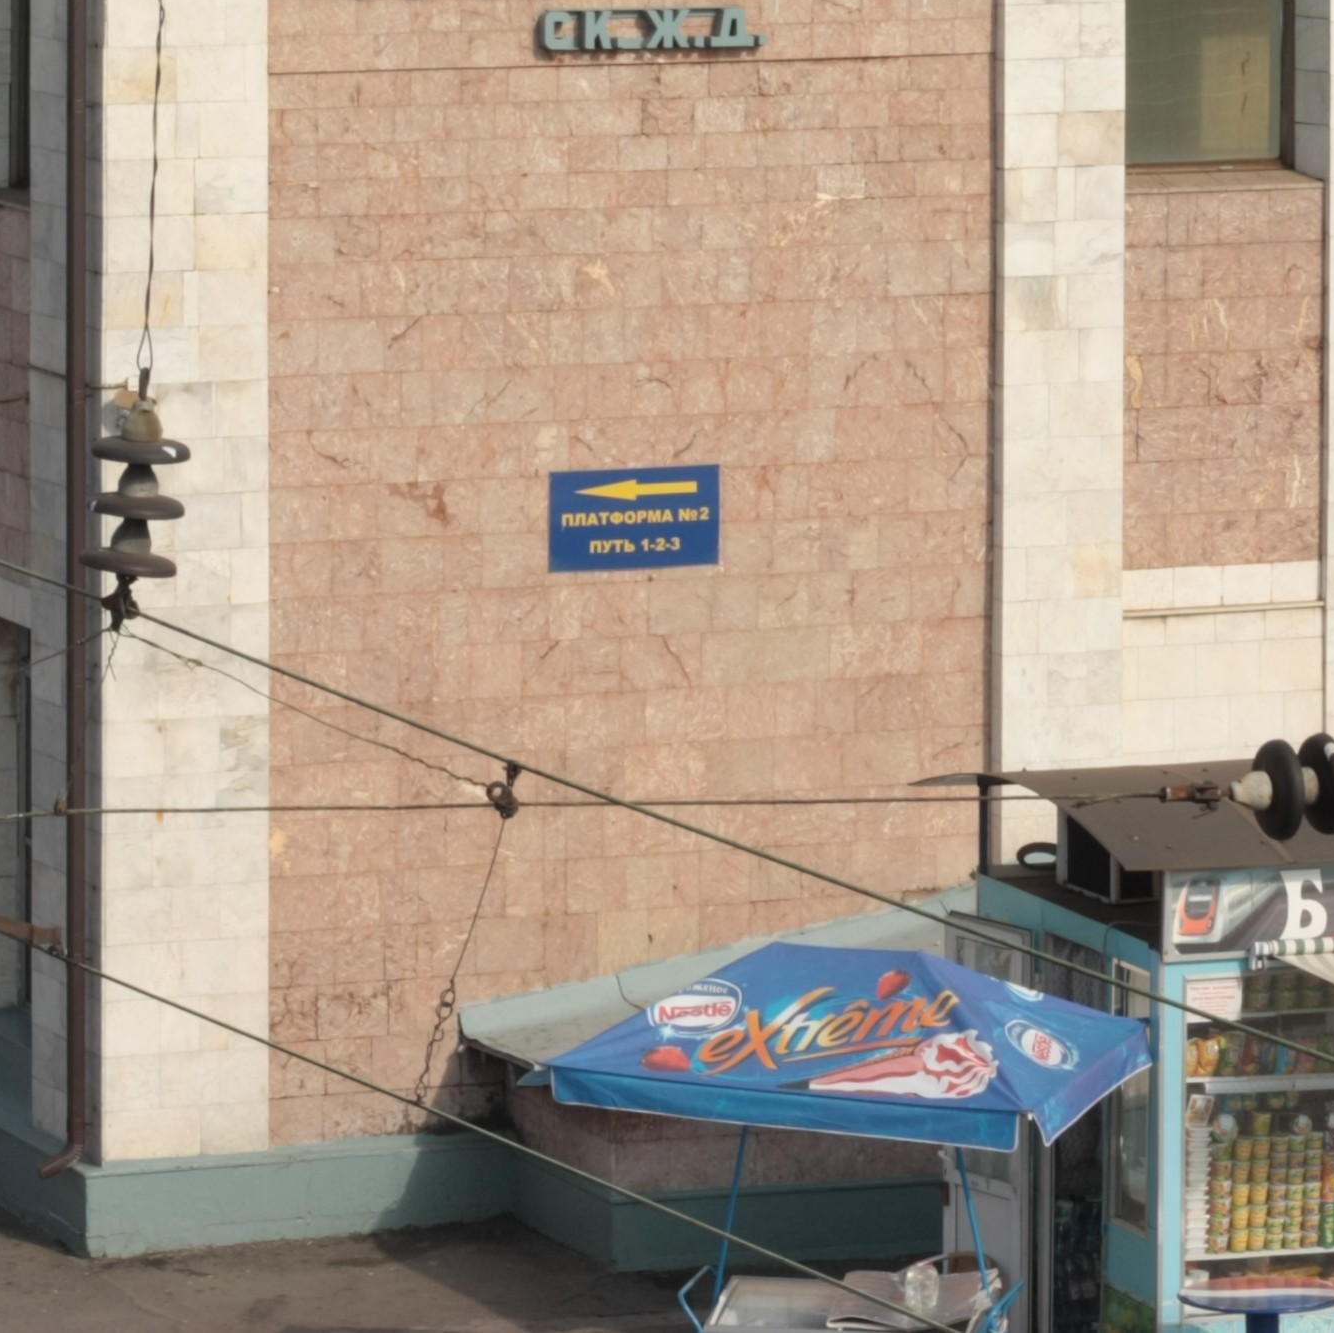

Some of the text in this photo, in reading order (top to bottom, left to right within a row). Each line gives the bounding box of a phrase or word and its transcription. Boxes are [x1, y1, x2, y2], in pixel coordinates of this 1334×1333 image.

[562, 509, 673, 527] ПЛАТФОРМА
[589, 537, 680, 554] ПУТЬ 1-2-3
